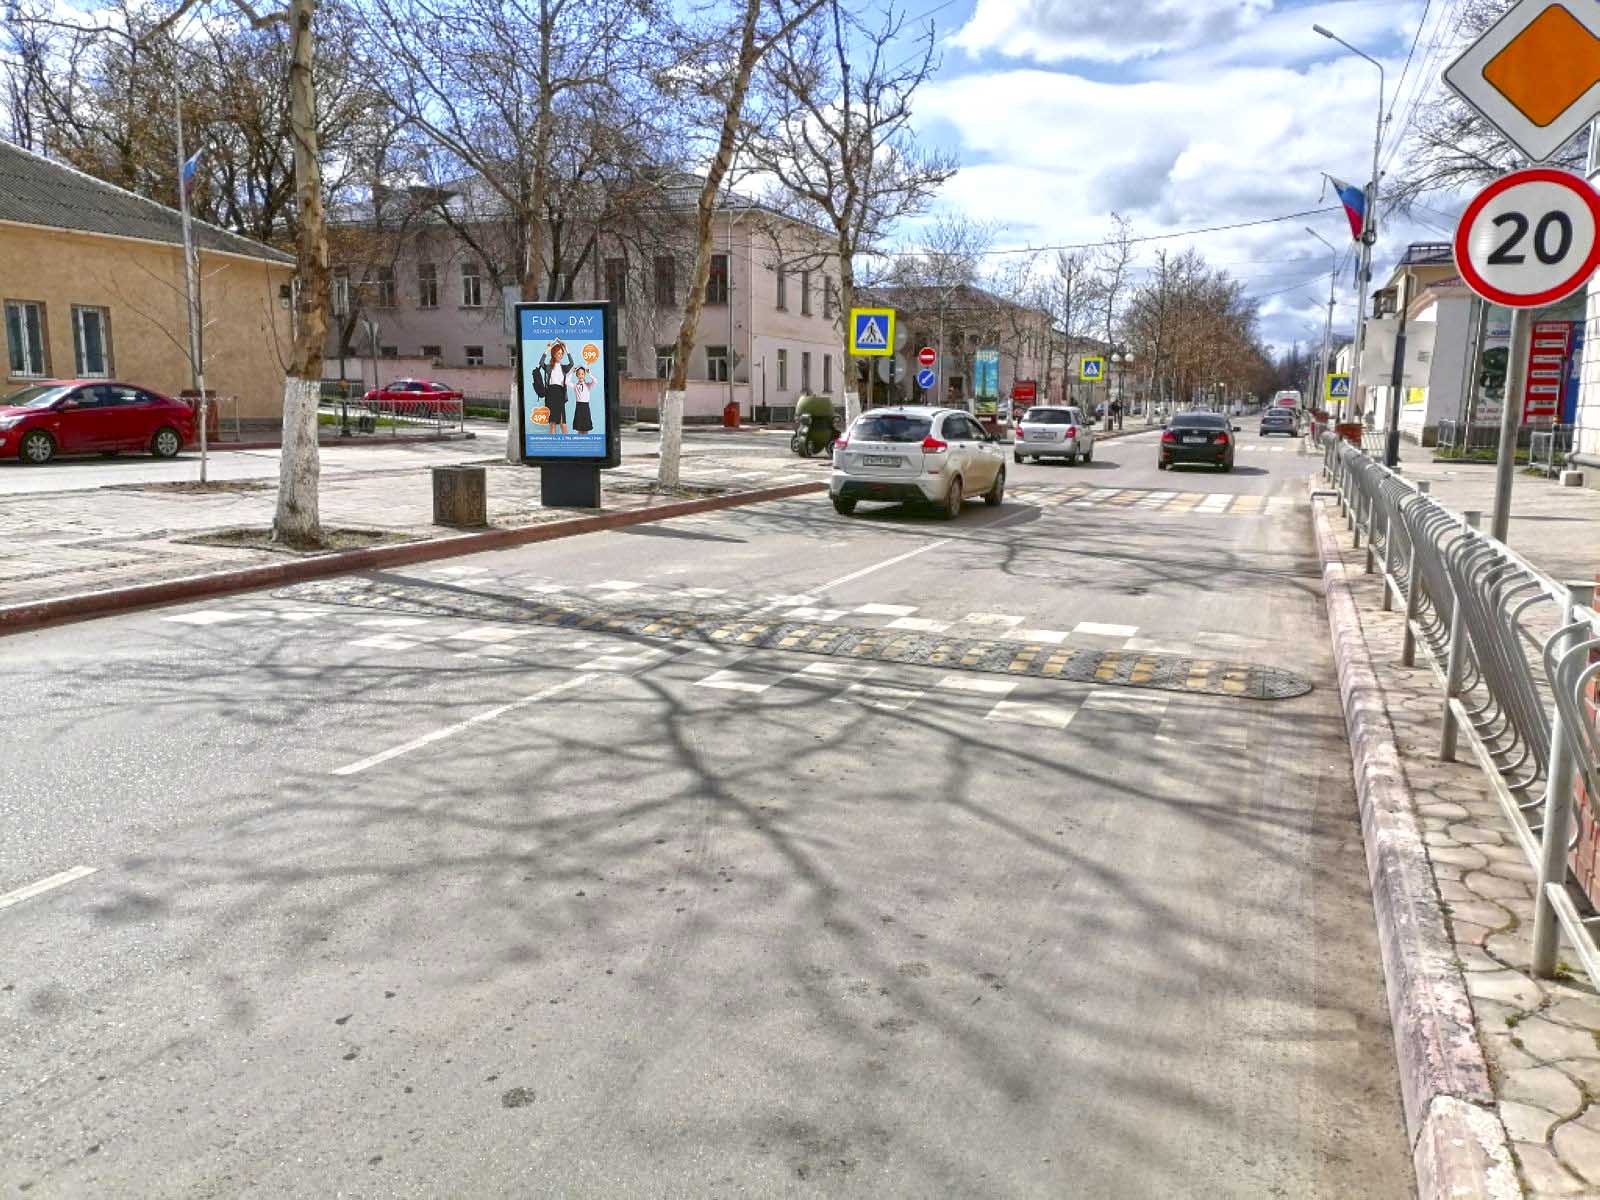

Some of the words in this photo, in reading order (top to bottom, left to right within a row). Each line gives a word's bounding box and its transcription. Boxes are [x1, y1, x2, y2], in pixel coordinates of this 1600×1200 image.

[1487, 210, 1573, 265] 20
[532, 315, 557, 326] FUN
[569, 315, 593, 326] DAY
